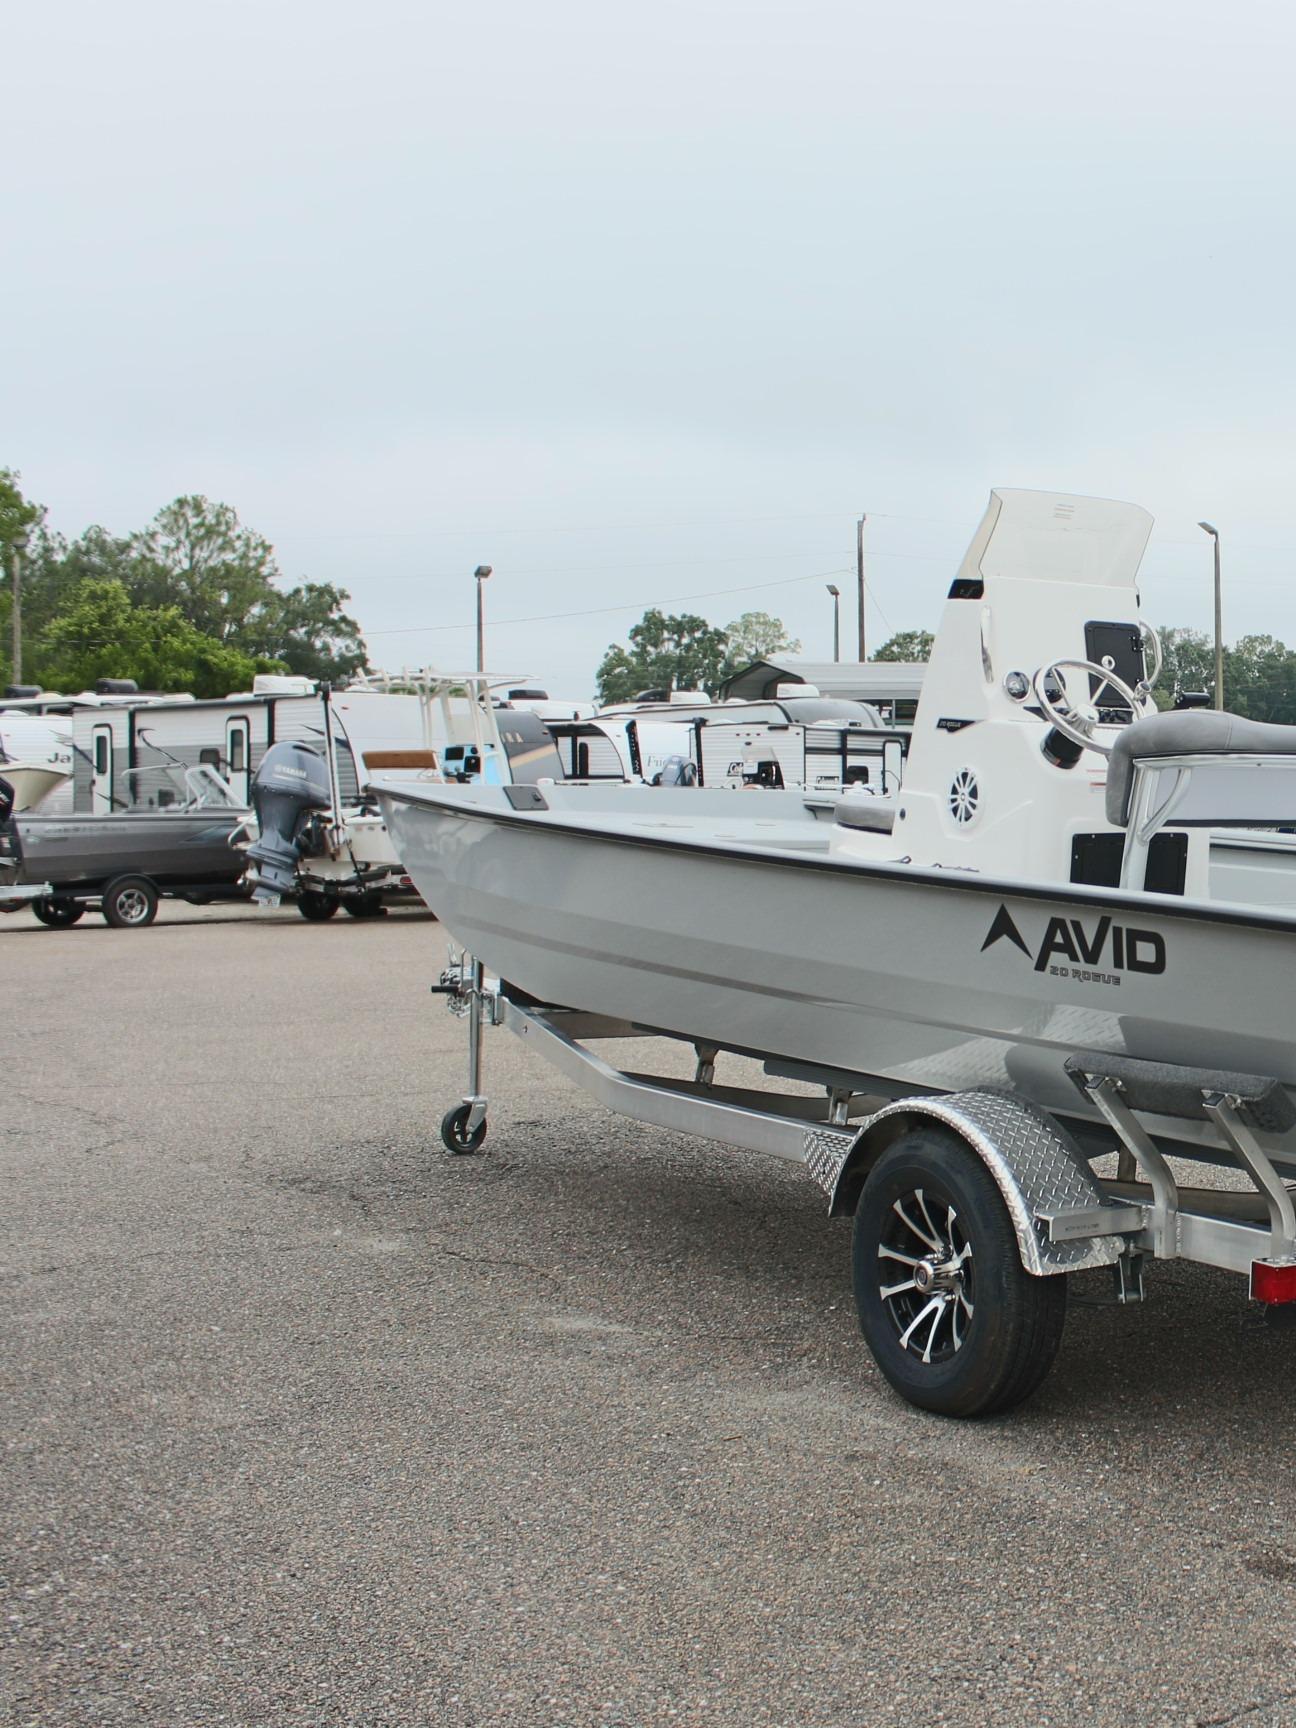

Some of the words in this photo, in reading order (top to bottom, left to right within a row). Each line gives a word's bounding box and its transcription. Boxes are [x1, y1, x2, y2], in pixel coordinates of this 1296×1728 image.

[1034, 916, 1166, 975] AVID
[1050, 965, 1069, 978] 20
[1072, 968, 1121, 986] ROGUE
